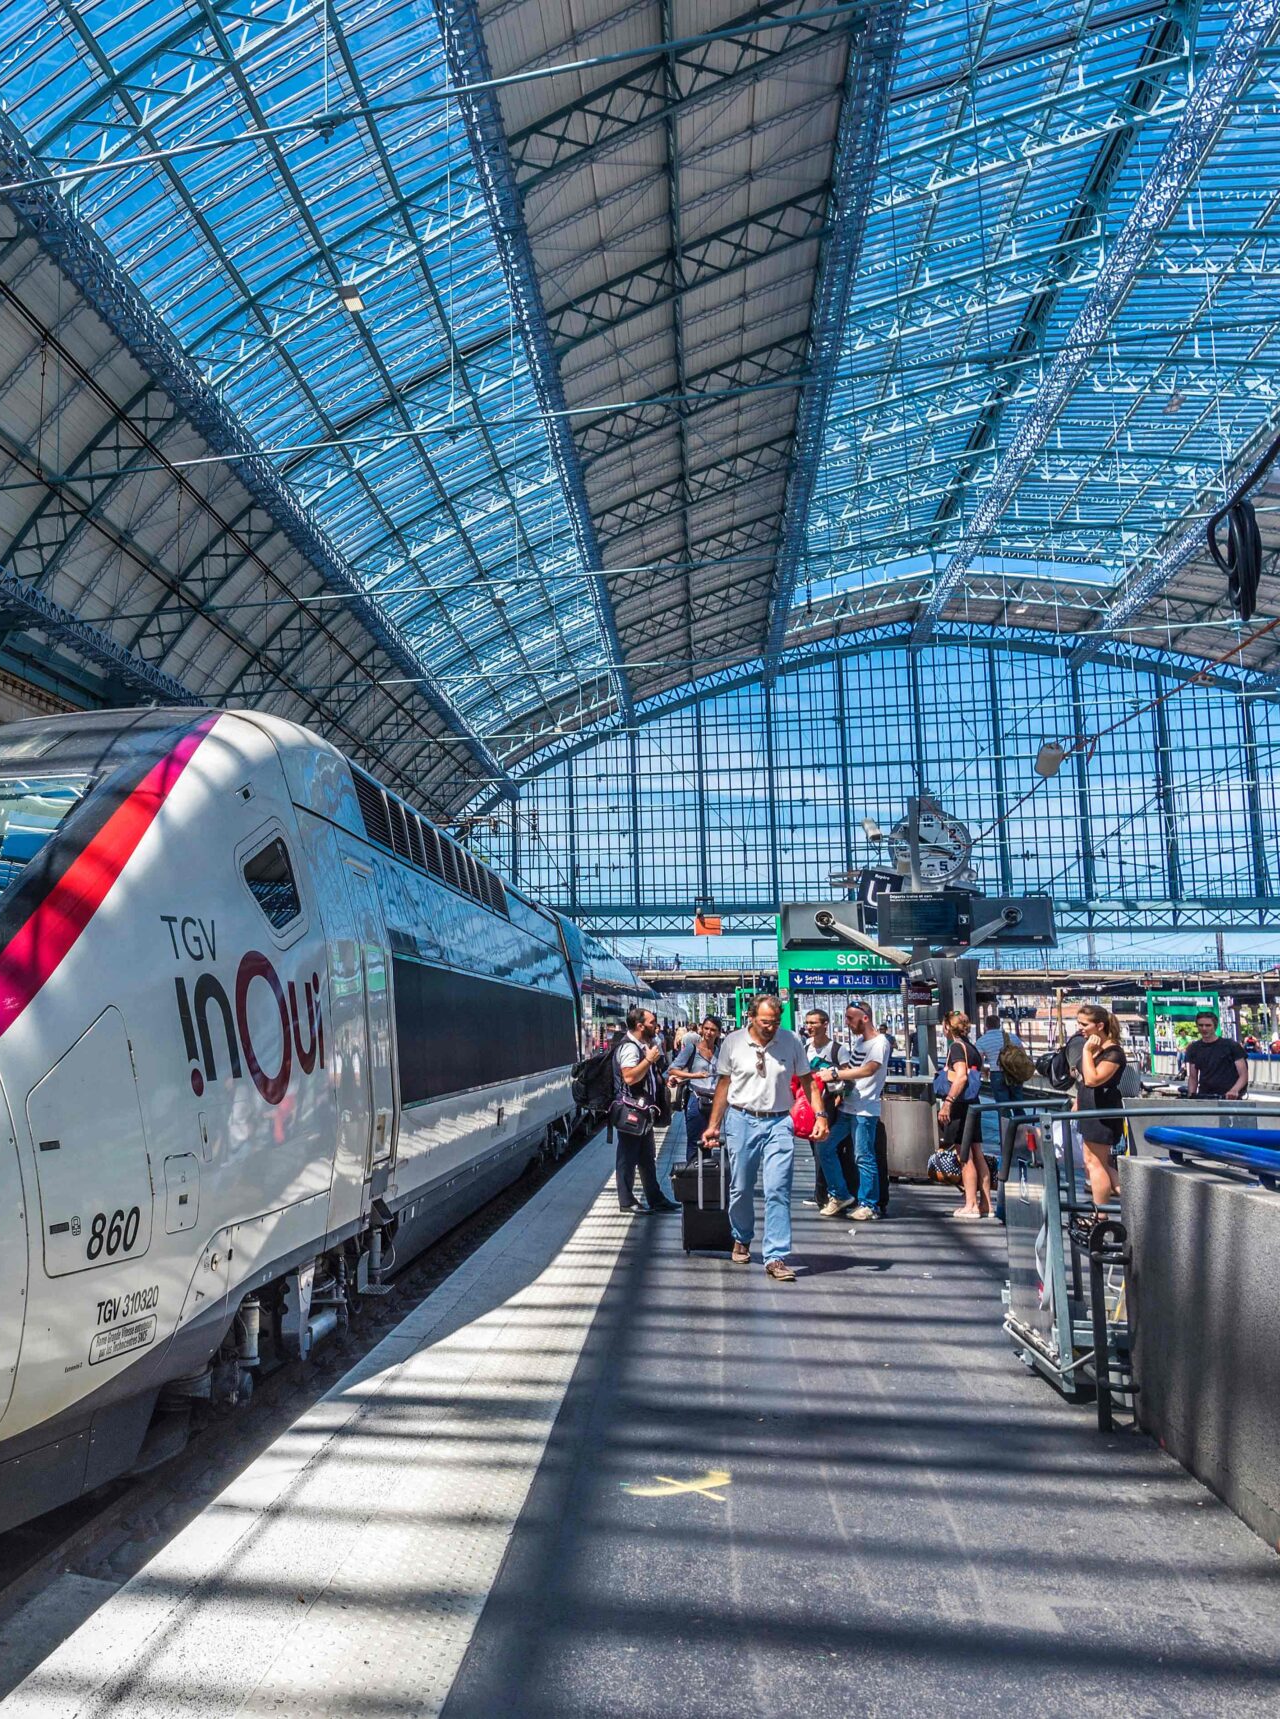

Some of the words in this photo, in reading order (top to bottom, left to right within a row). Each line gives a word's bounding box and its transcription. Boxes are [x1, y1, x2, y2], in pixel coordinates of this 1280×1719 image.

[160, 915, 216, 961] TGV
[86, 1206, 141, 1261] 860
[97, 1297, 122, 1326] TGV
[122, 1285, 160, 1318] 310320
[108, 1329, 121, 1343] Grande
[122, 1326, 135, 1339] Vitesse
